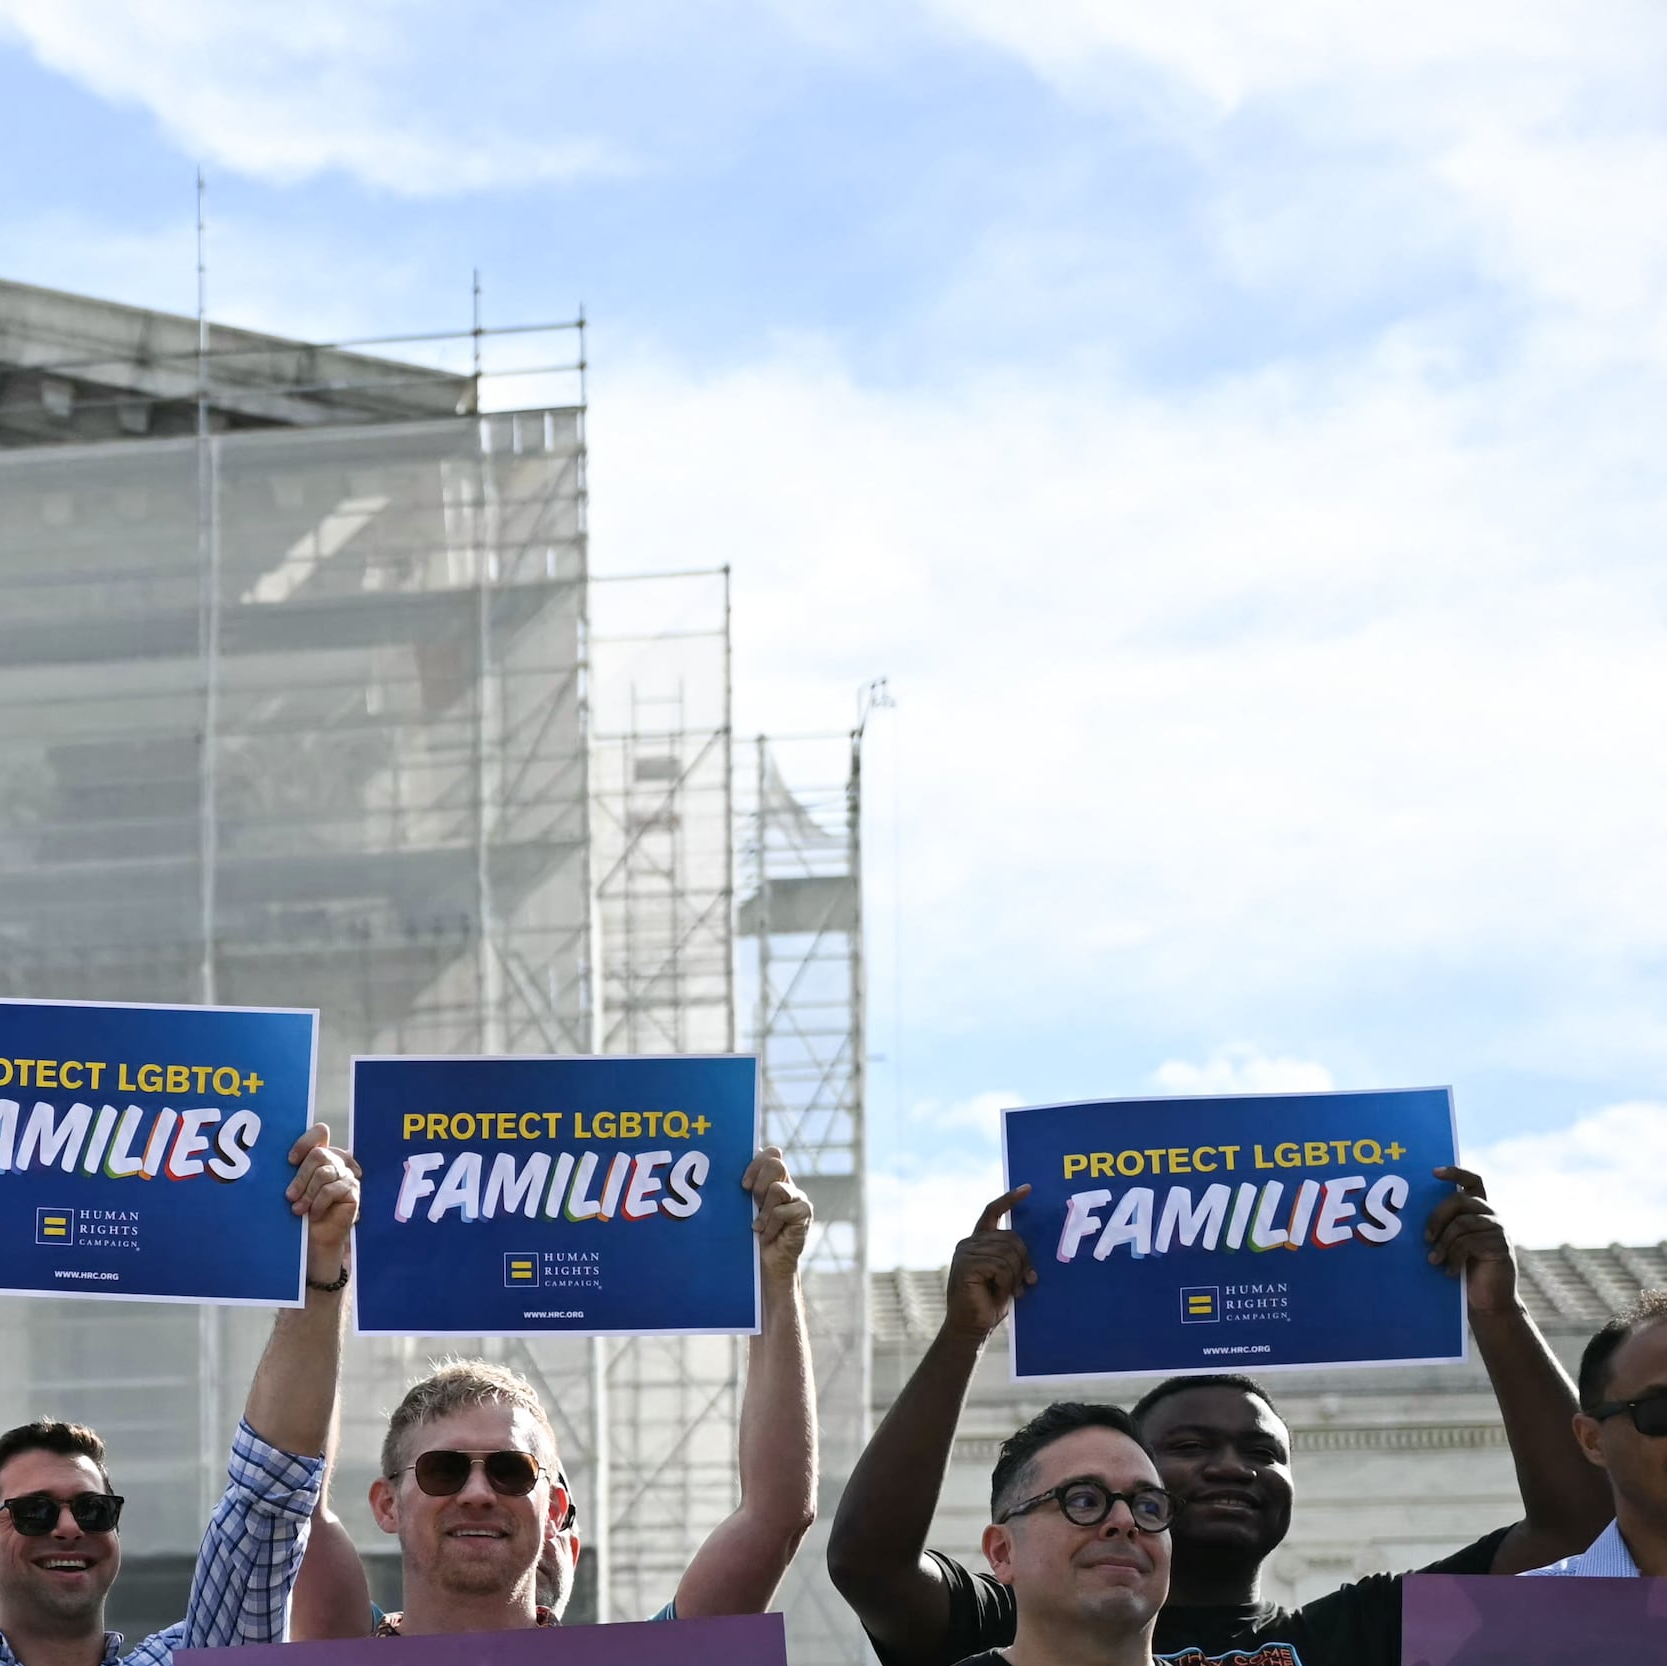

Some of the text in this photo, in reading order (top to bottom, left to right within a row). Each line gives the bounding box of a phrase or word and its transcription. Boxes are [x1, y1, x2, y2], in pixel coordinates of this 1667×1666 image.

[118, 1063, 265, 1098] LGBTQ+
[403, 1111, 712, 1140] PROTECT LGBTQ+
[1063, 1139, 1407, 1179] PROTECT LGBTQ+
[393, 1150, 710, 1223] FAMILIES
[79, 1210, 139, 1220] HUMAN
[1056, 1174, 1409, 1263] FAMILIES
[79, 1224, 138, 1236] RIGHTS
[544, 1252, 599, 1262] HUMAN
[54, 1270, 119, 1280] WWW.HRC.ORG
[544, 1266, 600, 1276] RIGHTS
[1225, 1283, 1288, 1295] HUMAN
[1226, 1298, 1288, 1310] RIGHTS
[523, 1311, 584, 1319] WWW.HRC.ORG
[1203, 1345, 1271, 1355] WWW.HRC.ORG
